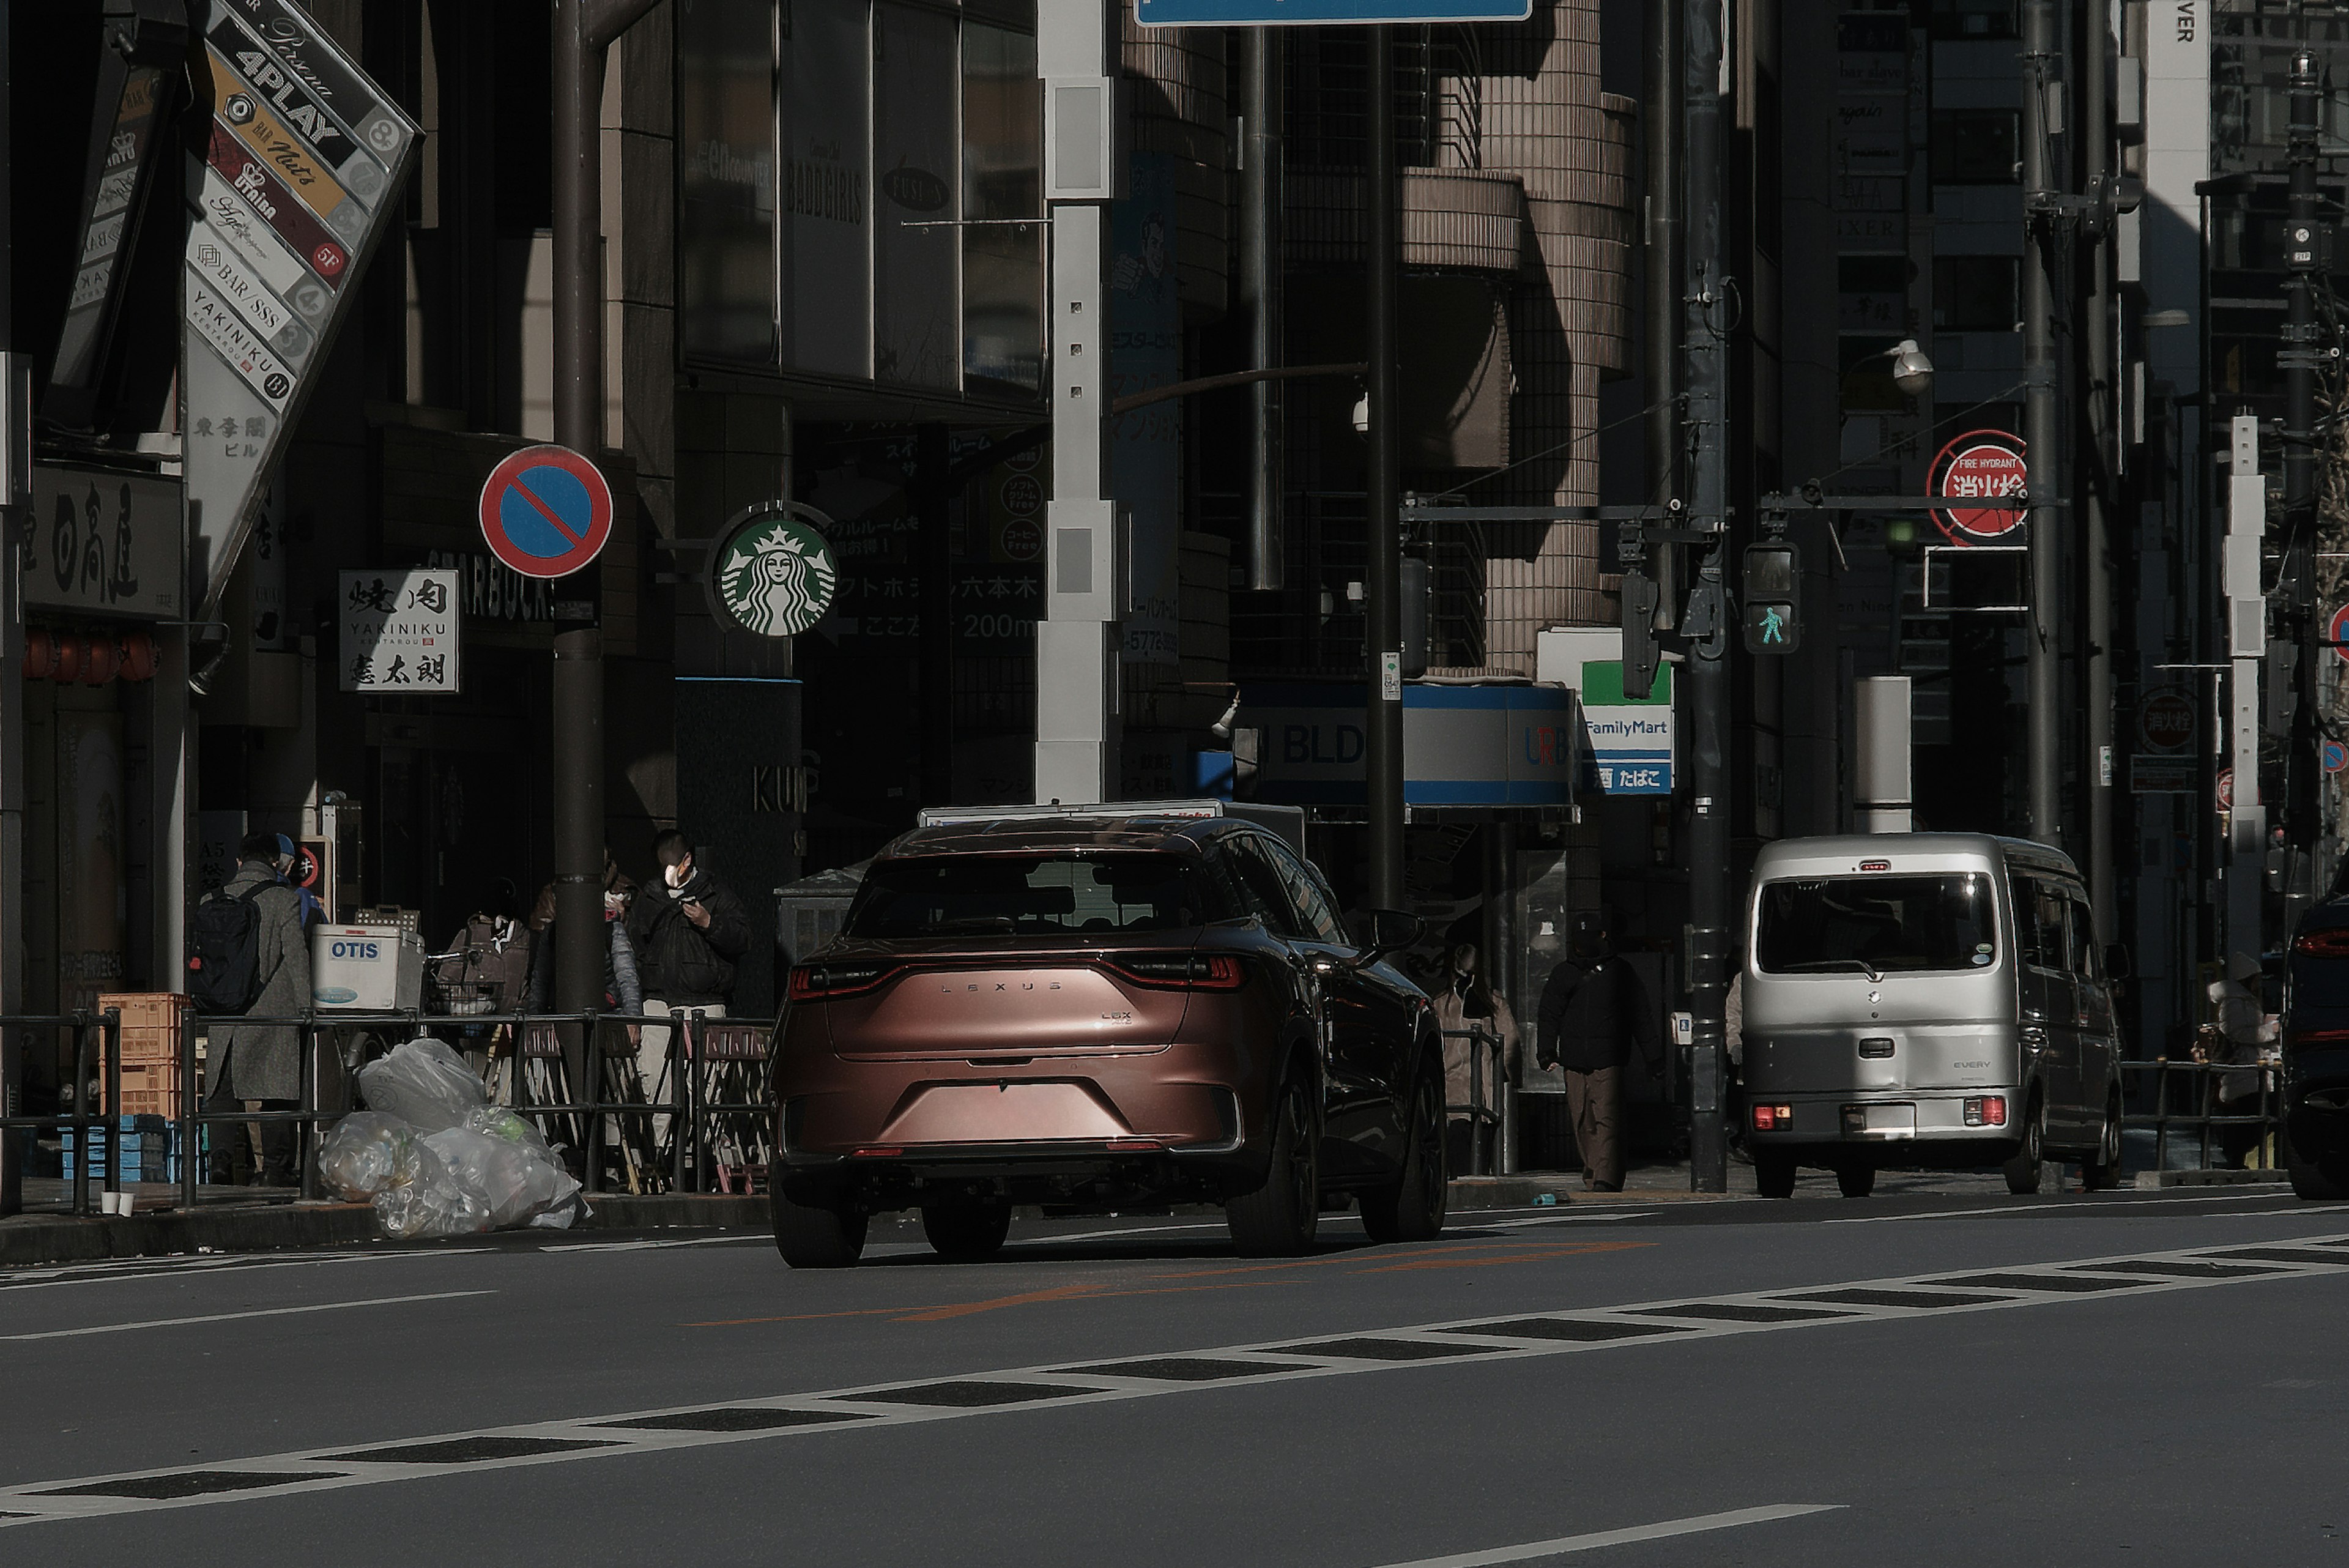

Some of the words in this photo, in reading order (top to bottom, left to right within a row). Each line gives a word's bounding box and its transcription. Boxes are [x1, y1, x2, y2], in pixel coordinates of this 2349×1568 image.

[236, 50, 341, 145] 4PLAY
[251, 122, 274, 144] BAR
[317, 247, 340, 269] 5F
[193, 290, 273, 372] YAKINIKU
[1959, 458, 1978, 469] FIRE
[1980, 458, 2017, 469] HYDRANT
[349, 578, 447, 614] 焼肉
[351, 623, 445, 634] YAKINIKU
[963, 614, 1037, 637] 200m
[1586, 720, 1668, 737] FamilyMart
[1619, 769, 1661, 787] たばこ
[332, 942, 378, 959] OTIS
[942, 981, 1062, 993] LEXUS
[1953, 1060, 1991, 1069] EVERY
